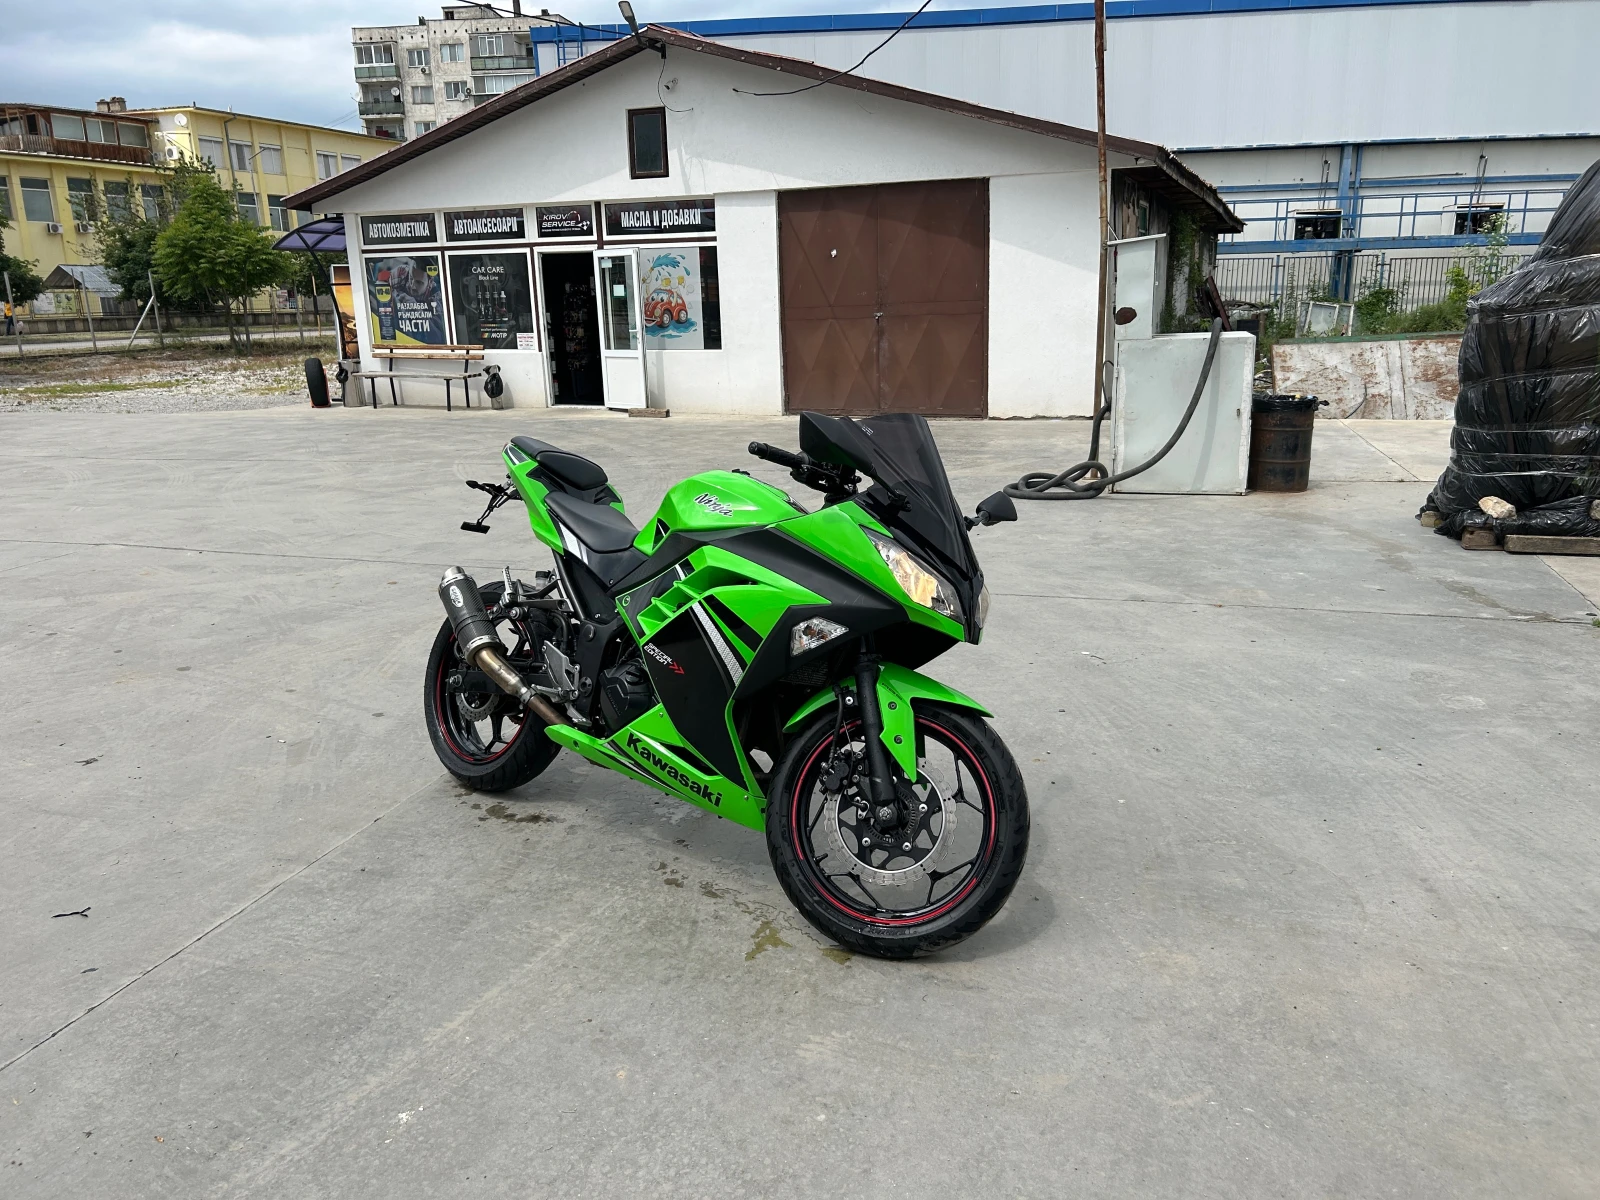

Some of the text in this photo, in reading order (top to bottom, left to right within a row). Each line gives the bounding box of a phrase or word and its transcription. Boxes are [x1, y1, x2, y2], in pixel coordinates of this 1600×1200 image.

[454, 216, 518, 235] АВТОАКСЕСОАРИ
[541, 220, 576, 228] SERVICE
[543, 213, 568, 221] KIROV
[620, 208, 701, 229] МАСЛА И ДОБАВКИ
[369, 221, 430, 239] АВТОКОЗМЕТИКА
[471, 266, 505, 274] CAR CARE
[398, 319, 431, 333] ЧАСТИ
[693, 492, 733, 518] Ninja
[648, 642, 673, 665] SPECIAL
[626, 731, 723, 808] Kawasaki
